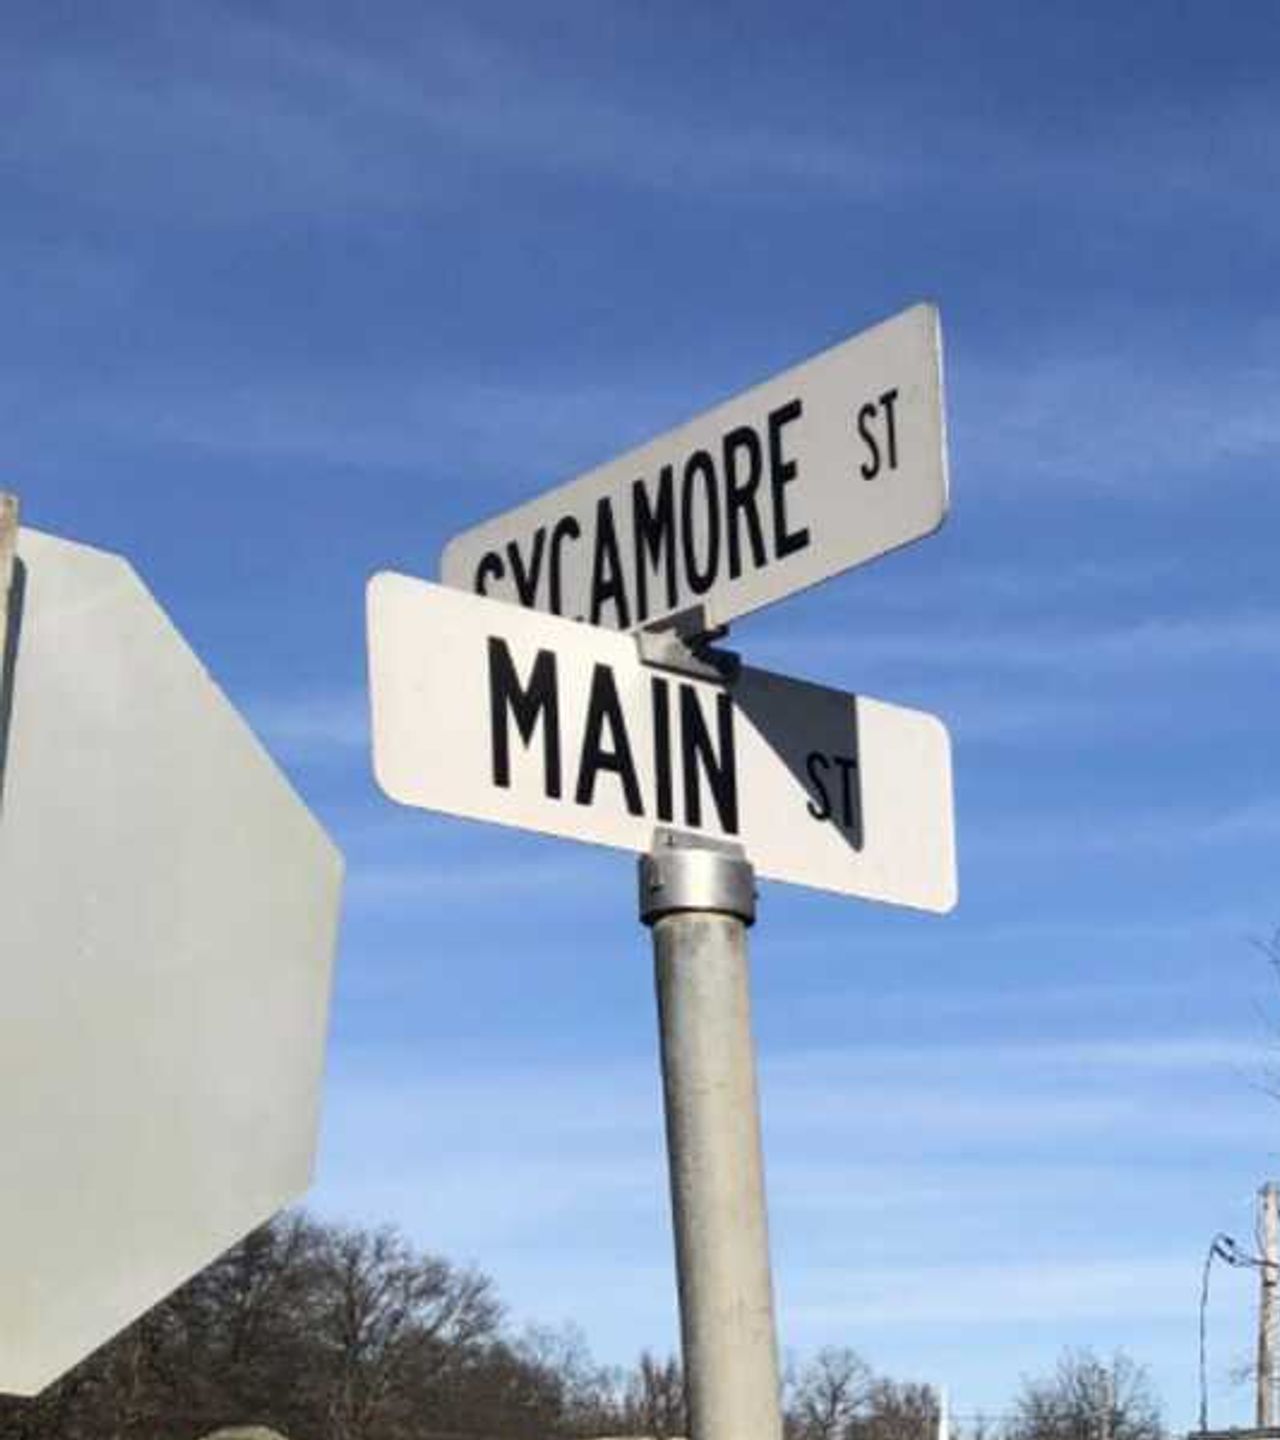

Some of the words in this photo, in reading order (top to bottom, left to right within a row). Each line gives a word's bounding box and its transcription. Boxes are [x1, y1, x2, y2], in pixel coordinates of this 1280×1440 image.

[857, 389, 898, 481] ST
[488, 636, 740, 836] MAIN
[806, 751, 858, 828] ST
